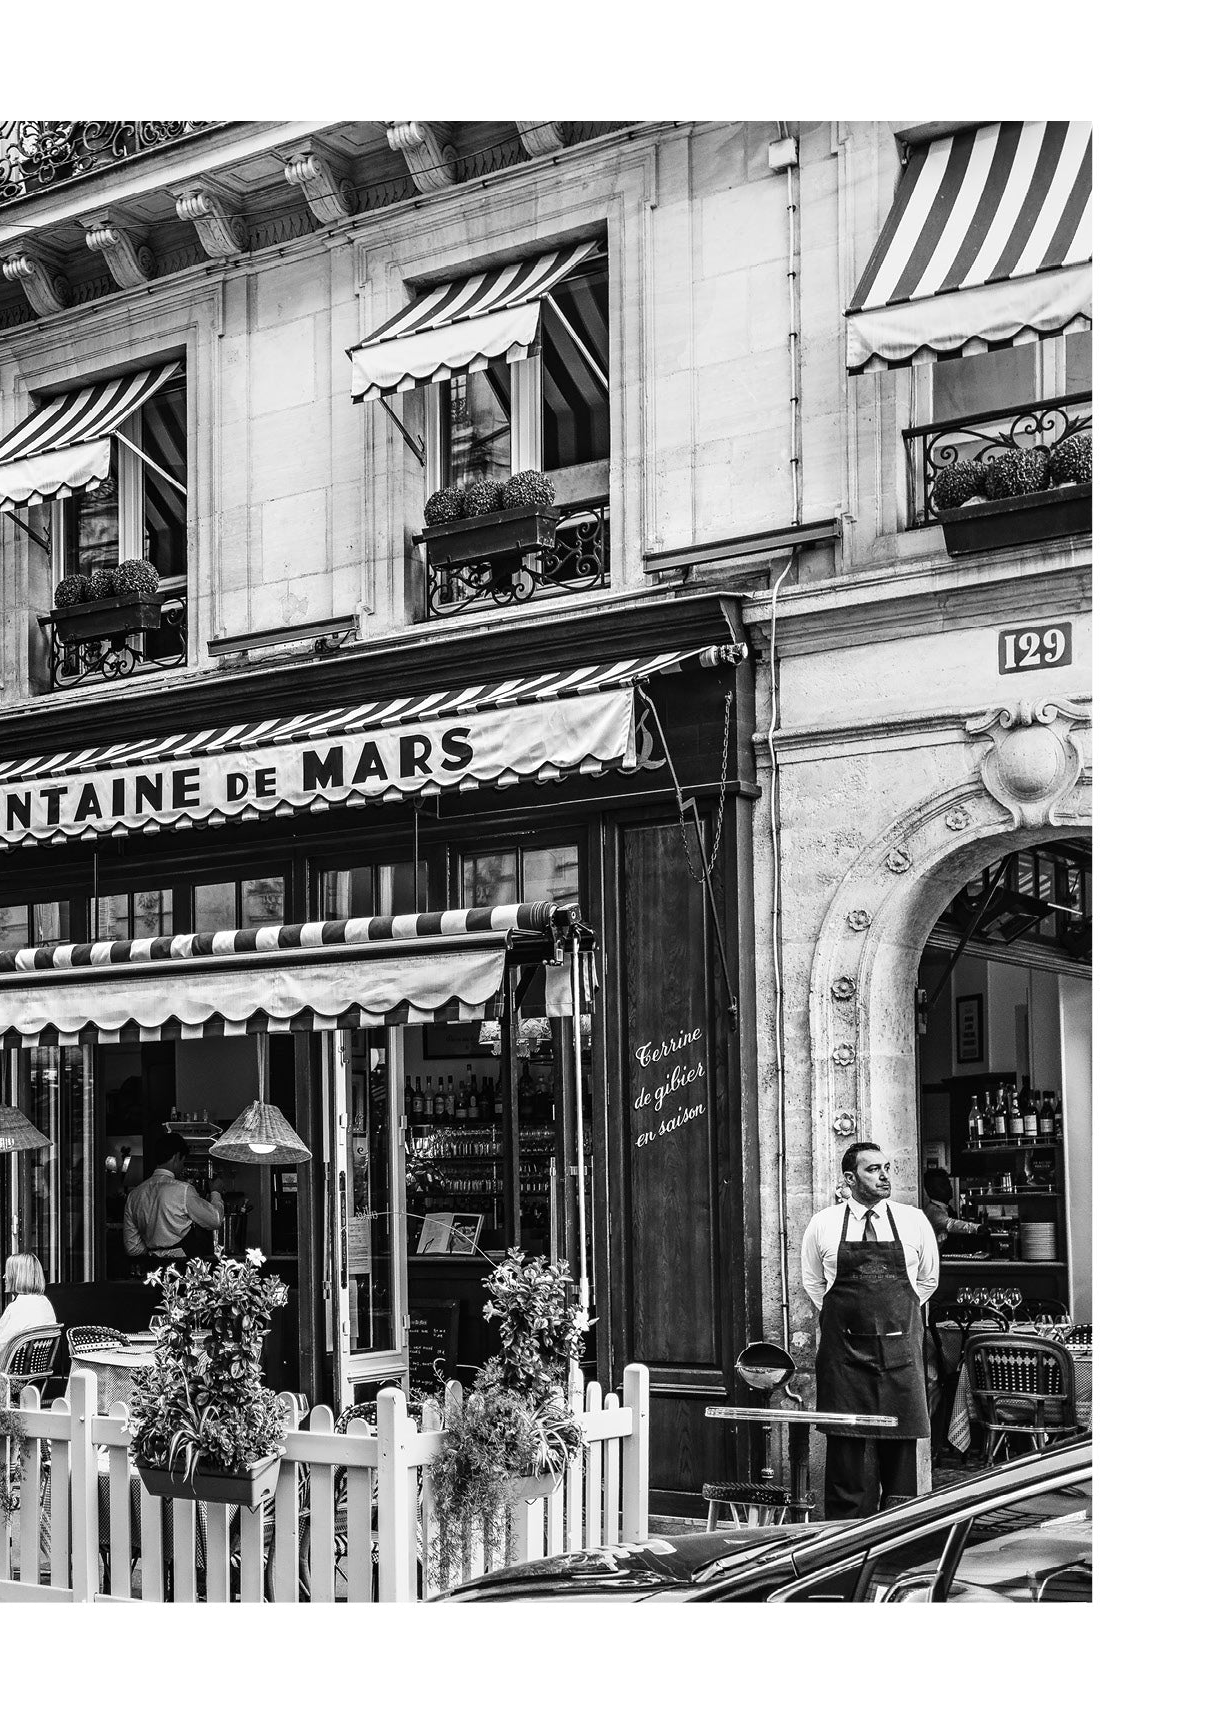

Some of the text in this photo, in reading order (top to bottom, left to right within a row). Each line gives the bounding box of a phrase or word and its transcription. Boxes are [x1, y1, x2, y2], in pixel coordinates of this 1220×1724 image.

[1004, 628, 1066, 669] 129
[226, 766, 277, 803] DE
[301, 726, 474, 793] MARS
[635, 1027, 702, 1068] Terrine
[634, 1061, 705, 1112] de gibier
[634, 1103, 706, 1148] en saison
